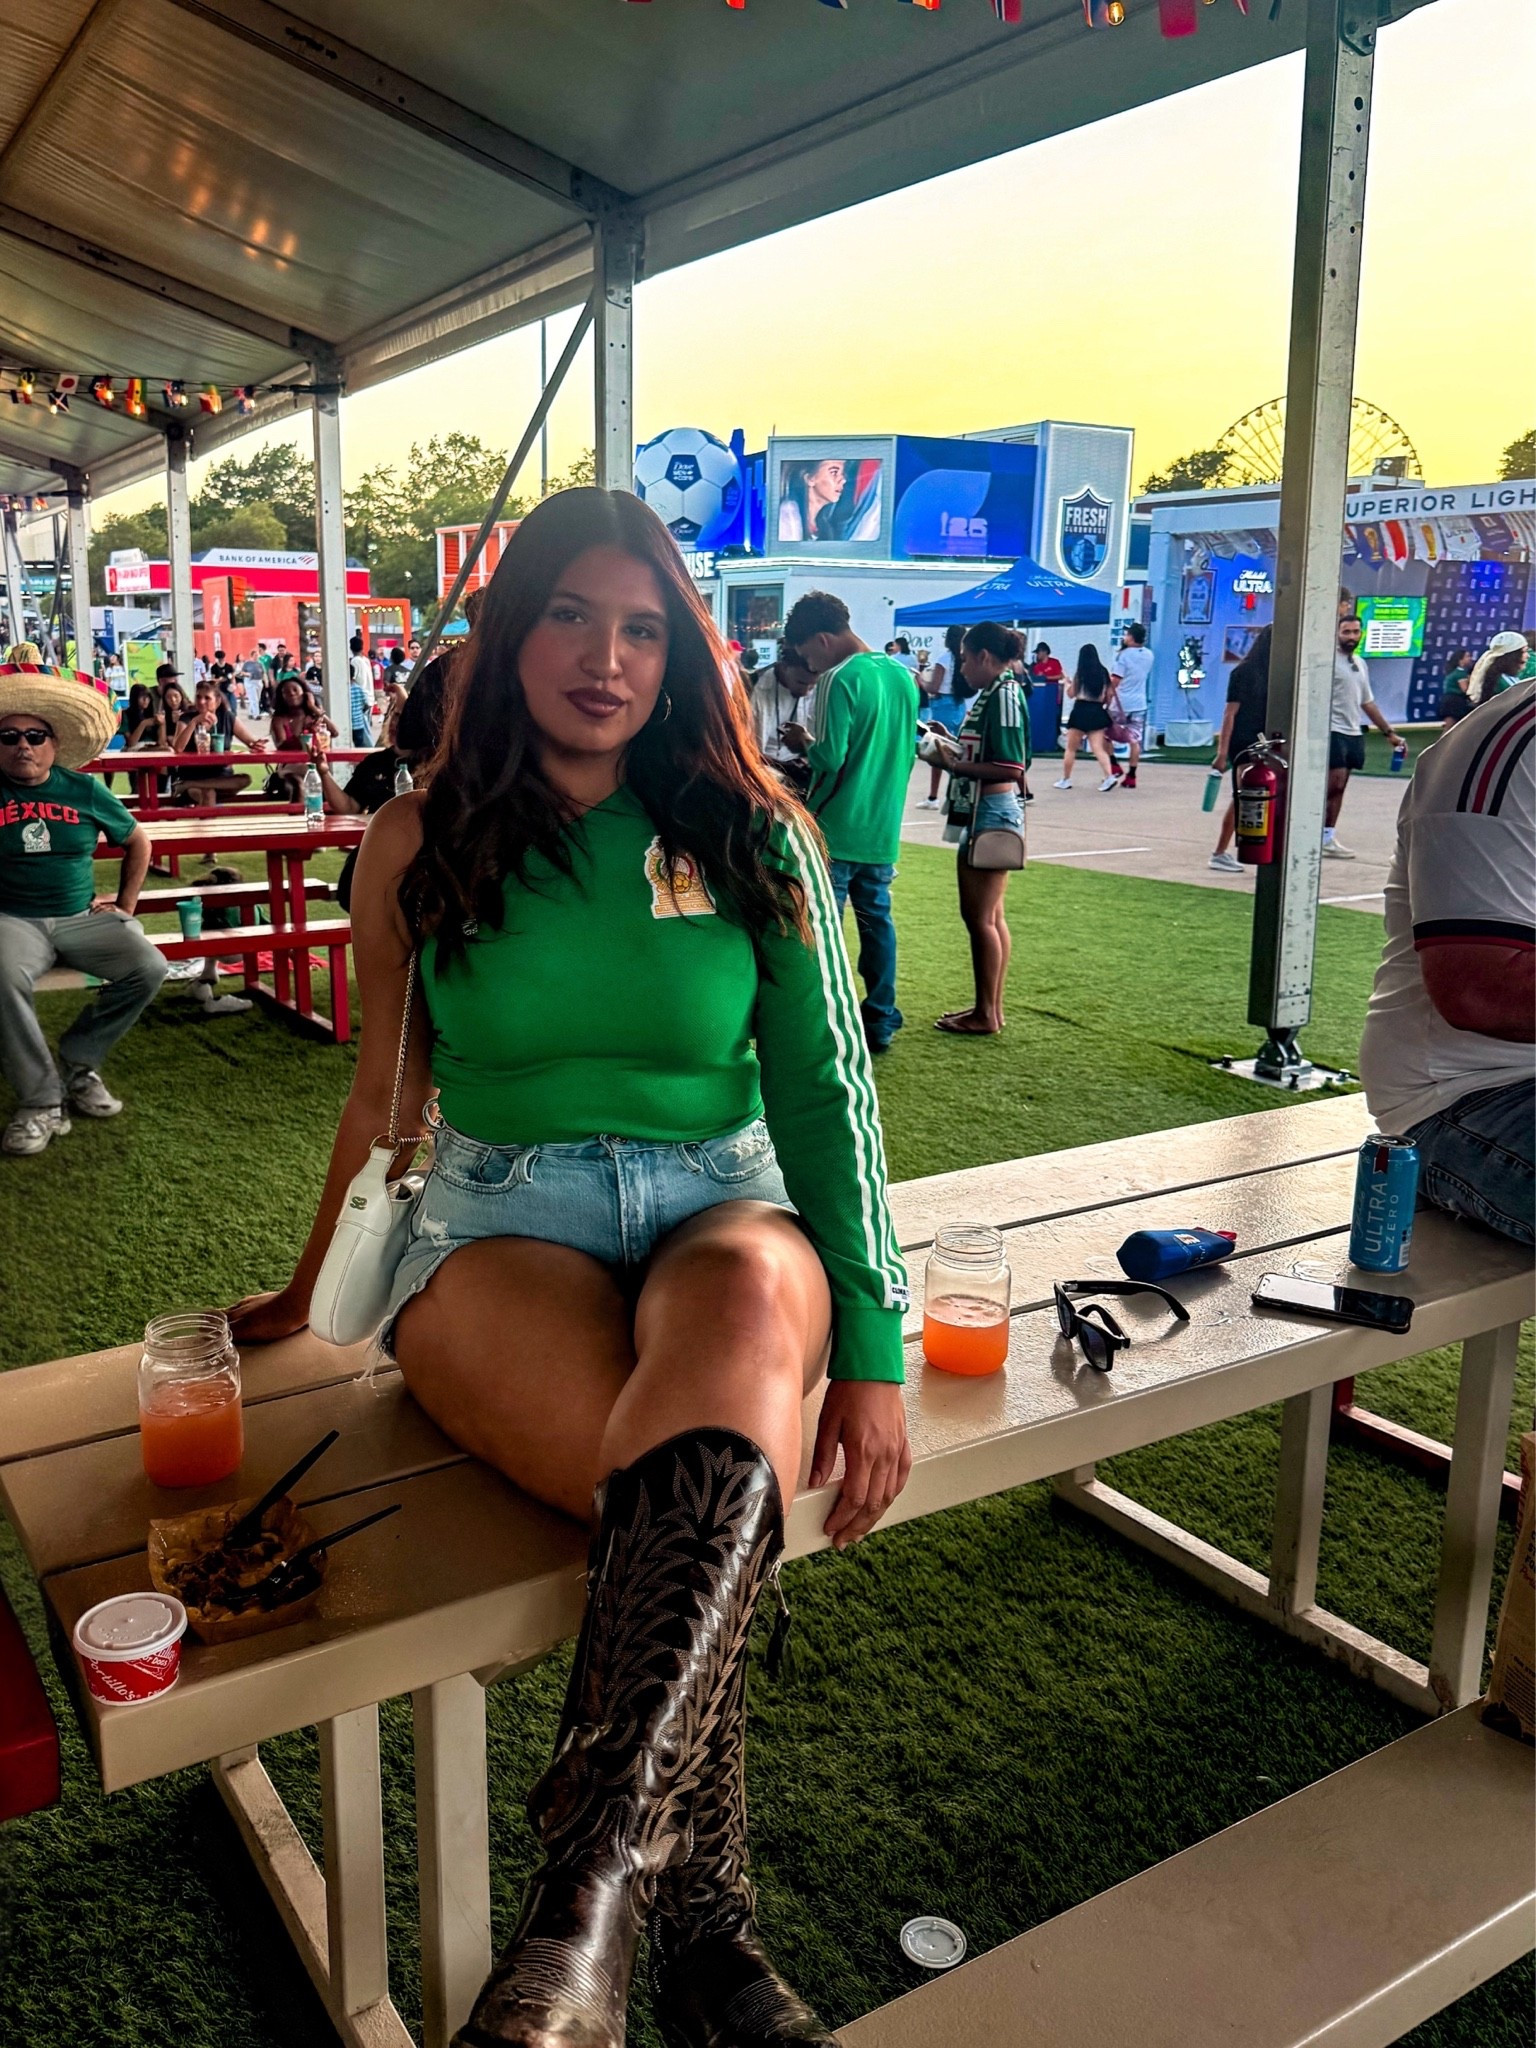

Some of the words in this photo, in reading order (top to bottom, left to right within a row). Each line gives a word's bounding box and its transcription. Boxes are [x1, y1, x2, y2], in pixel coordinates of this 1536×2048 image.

[1065, 507, 1107, 527] FRESH
[1346, 494, 1456, 518] UPERIOR
[258, 556, 297, 565] AMERICA
[683, 551, 715, 578] USE
[1026, 580, 1075, 588] ULTRA
[1233, 580, 1273, 593] ULTRA
[1364, 1182, 1388, 1253] ULTRA
[1385, 1194, 1399, 1244] ZERO
